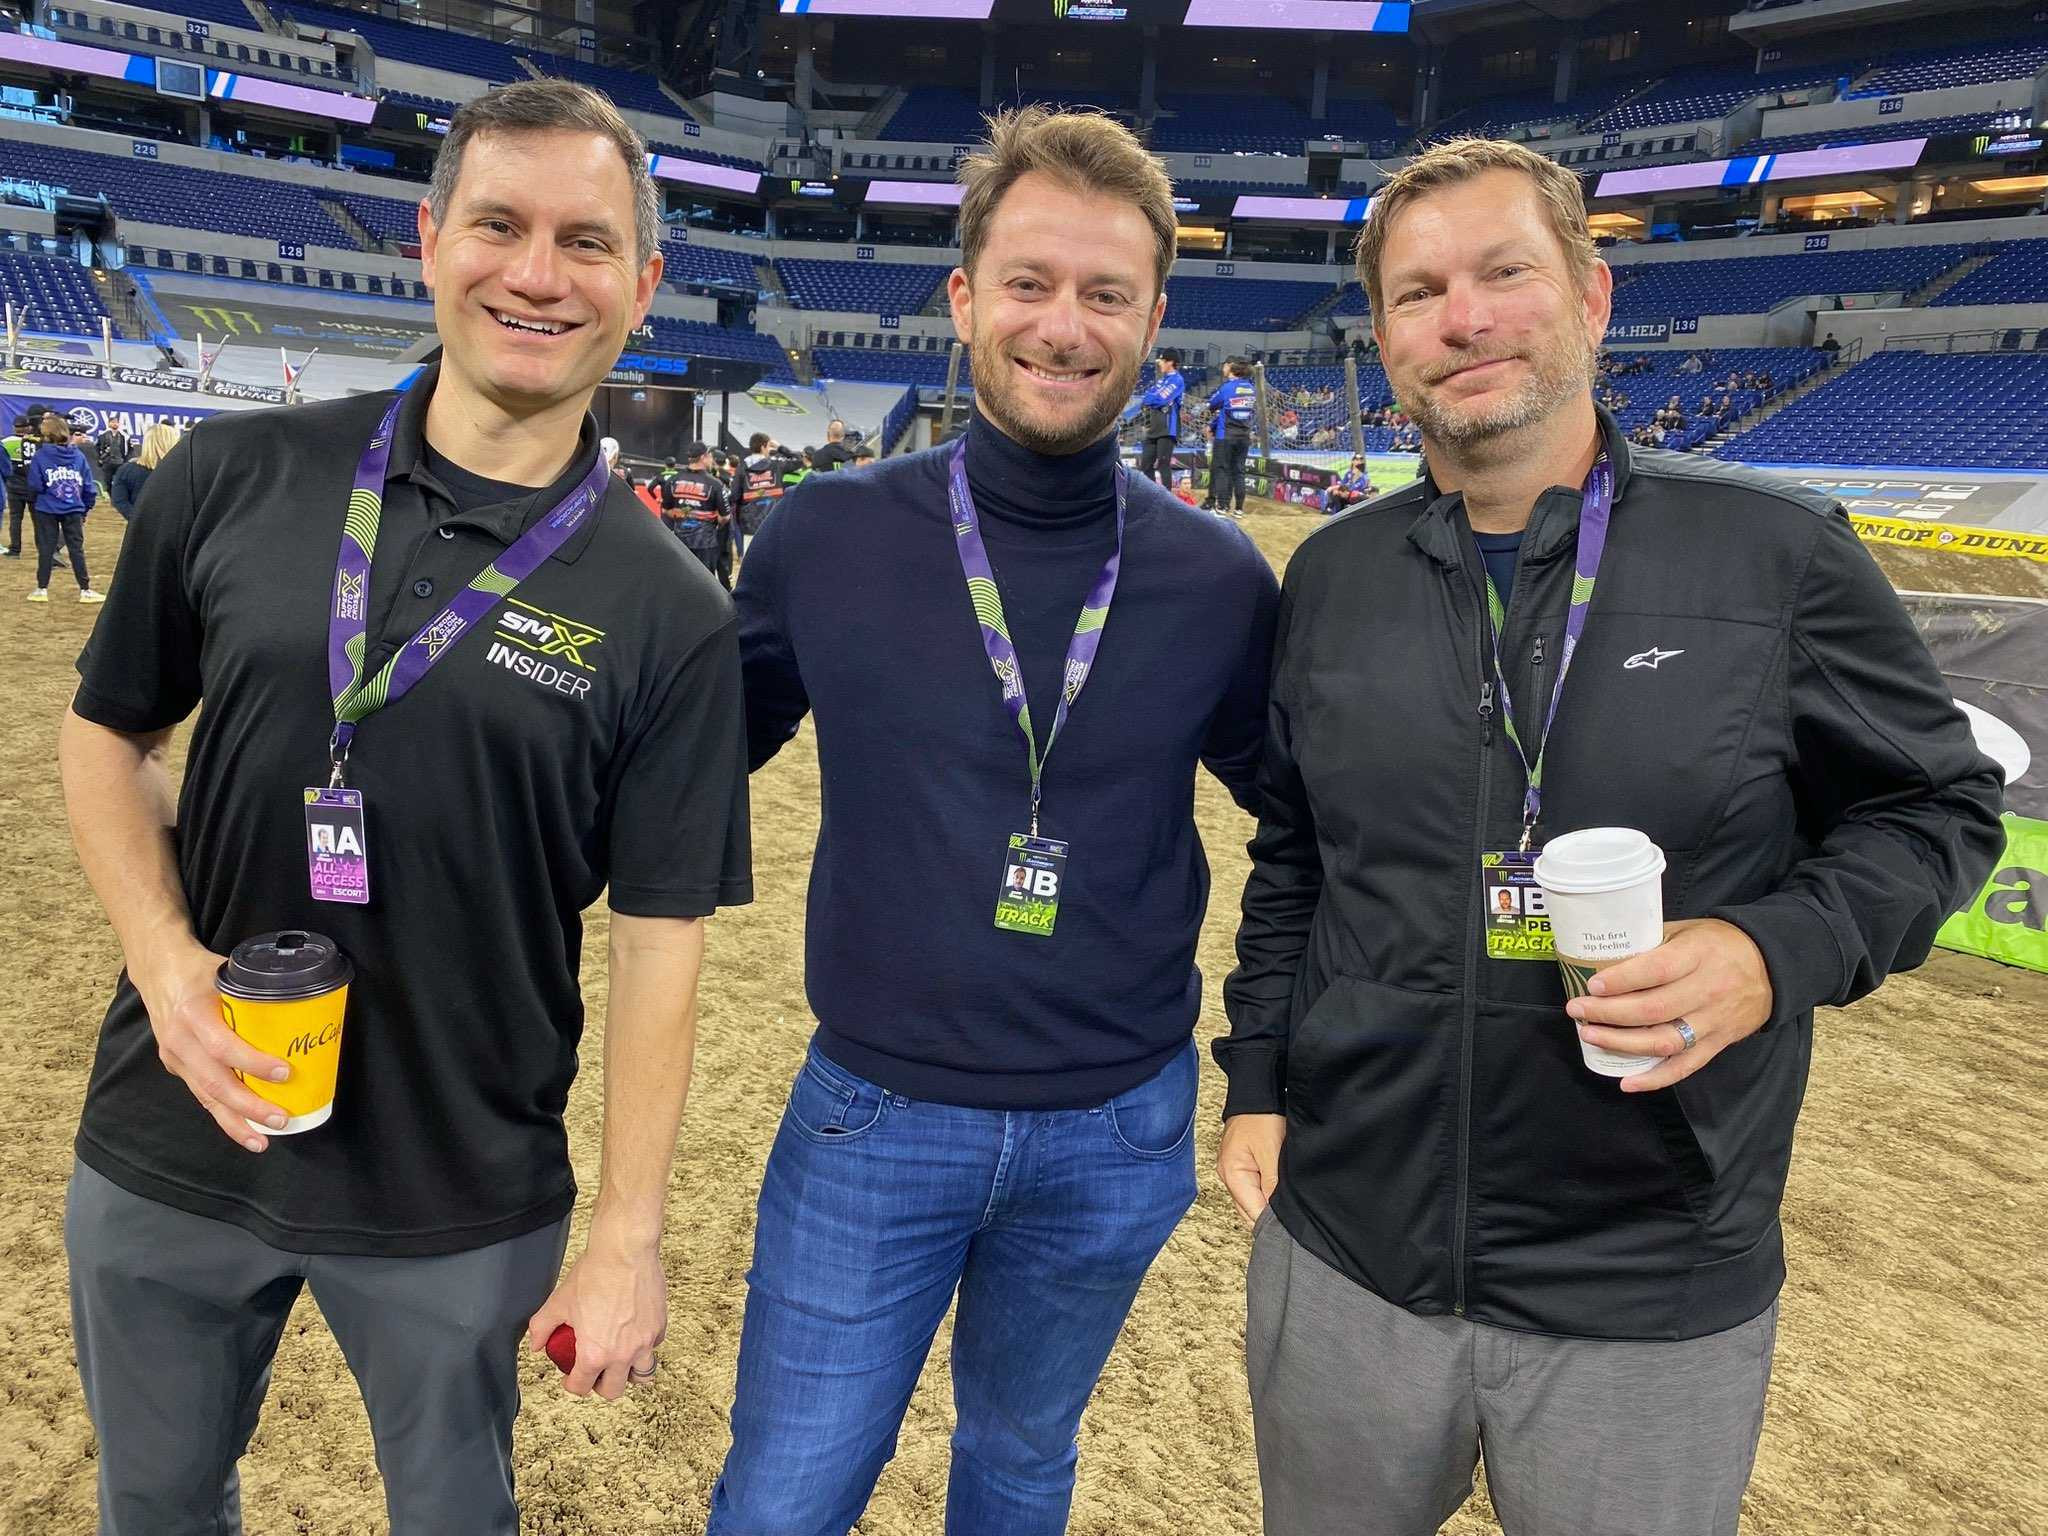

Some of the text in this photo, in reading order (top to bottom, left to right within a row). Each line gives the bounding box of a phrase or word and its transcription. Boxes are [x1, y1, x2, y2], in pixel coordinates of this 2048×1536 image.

[187, 22, 208, 36] 328
[1880, 101, 1901, 112] 336
[684, 124, 699, 135] 330
[134, 143, 157, 156] 228
[671, 228, 687, 240] 230
[1806, 237, 1827, 248] 236
[280, 245, 303, 257] 128
[857, 248, 874, 258] 231
[1217, 265, 1233, 274] 233
[881, 315, 898, 327] 132
[1675, 320, 1696, 331] 136
[1800, 479, 1983, 493] GoPro
[498, 610, 598, 667] SMX
[486, 642, 592, 700] INSIDER
[336, 826, 363, 856] A
[314, 861, 337, 874] ALL
[314, 874, 364, 888] ACCESS
[1033, 869, 1058, 897] B
[999, 907, 1052, 928] TRACK
[1583, 931, 1627, 941] That first
[1490, 935, 1556, 951] TRACK
[1583, 942, 1631, 952] sip feeling
